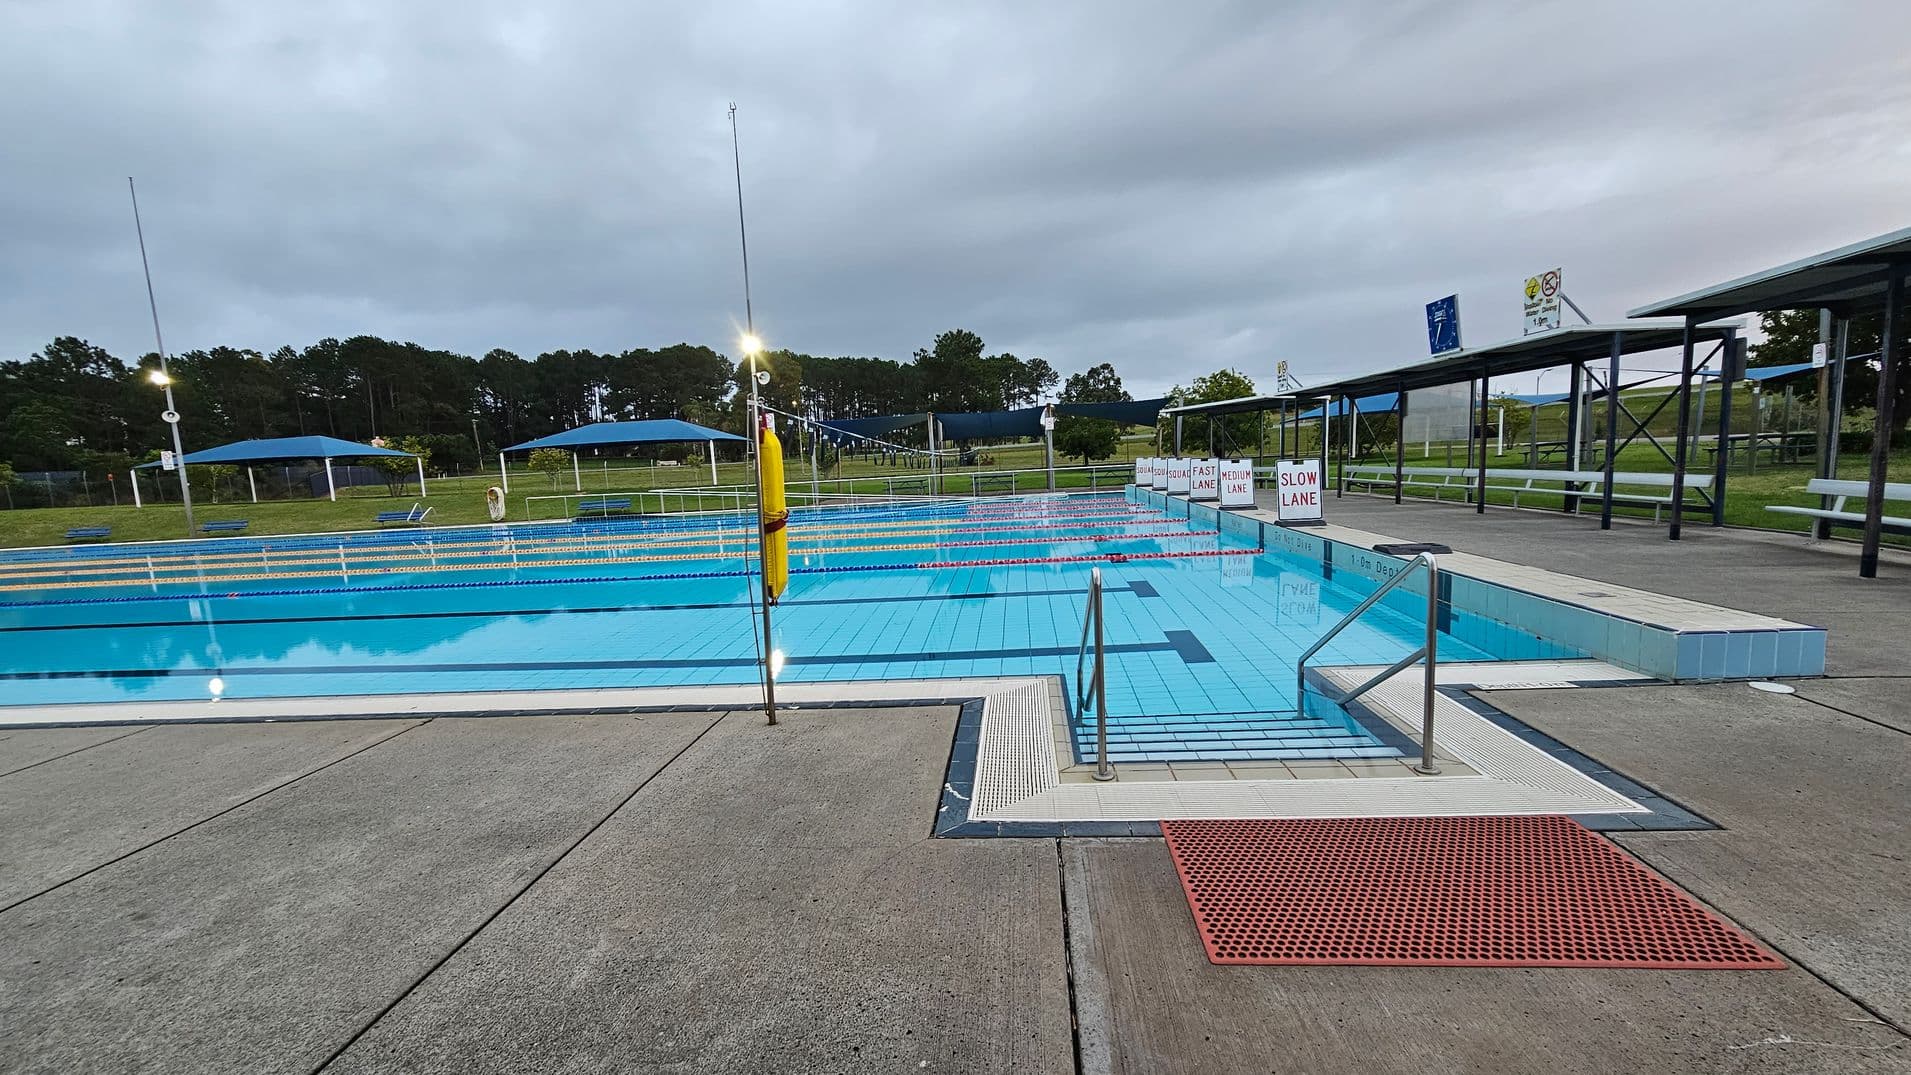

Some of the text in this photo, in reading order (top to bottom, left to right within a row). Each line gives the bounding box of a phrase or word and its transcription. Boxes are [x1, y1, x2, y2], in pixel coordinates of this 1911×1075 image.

[1136, 466, 1152, 474] SQUA
[1193, 466, 1216, 477] FAST
[1222, 470, 1251, 481] MEDIUM
[1193, 479, 1216, 490] LANE
[1281, 472, 1317, 486] SLOW
[1227, 483, 1247, 494] LANE
[1282, 492, 1318, 507] LANE
